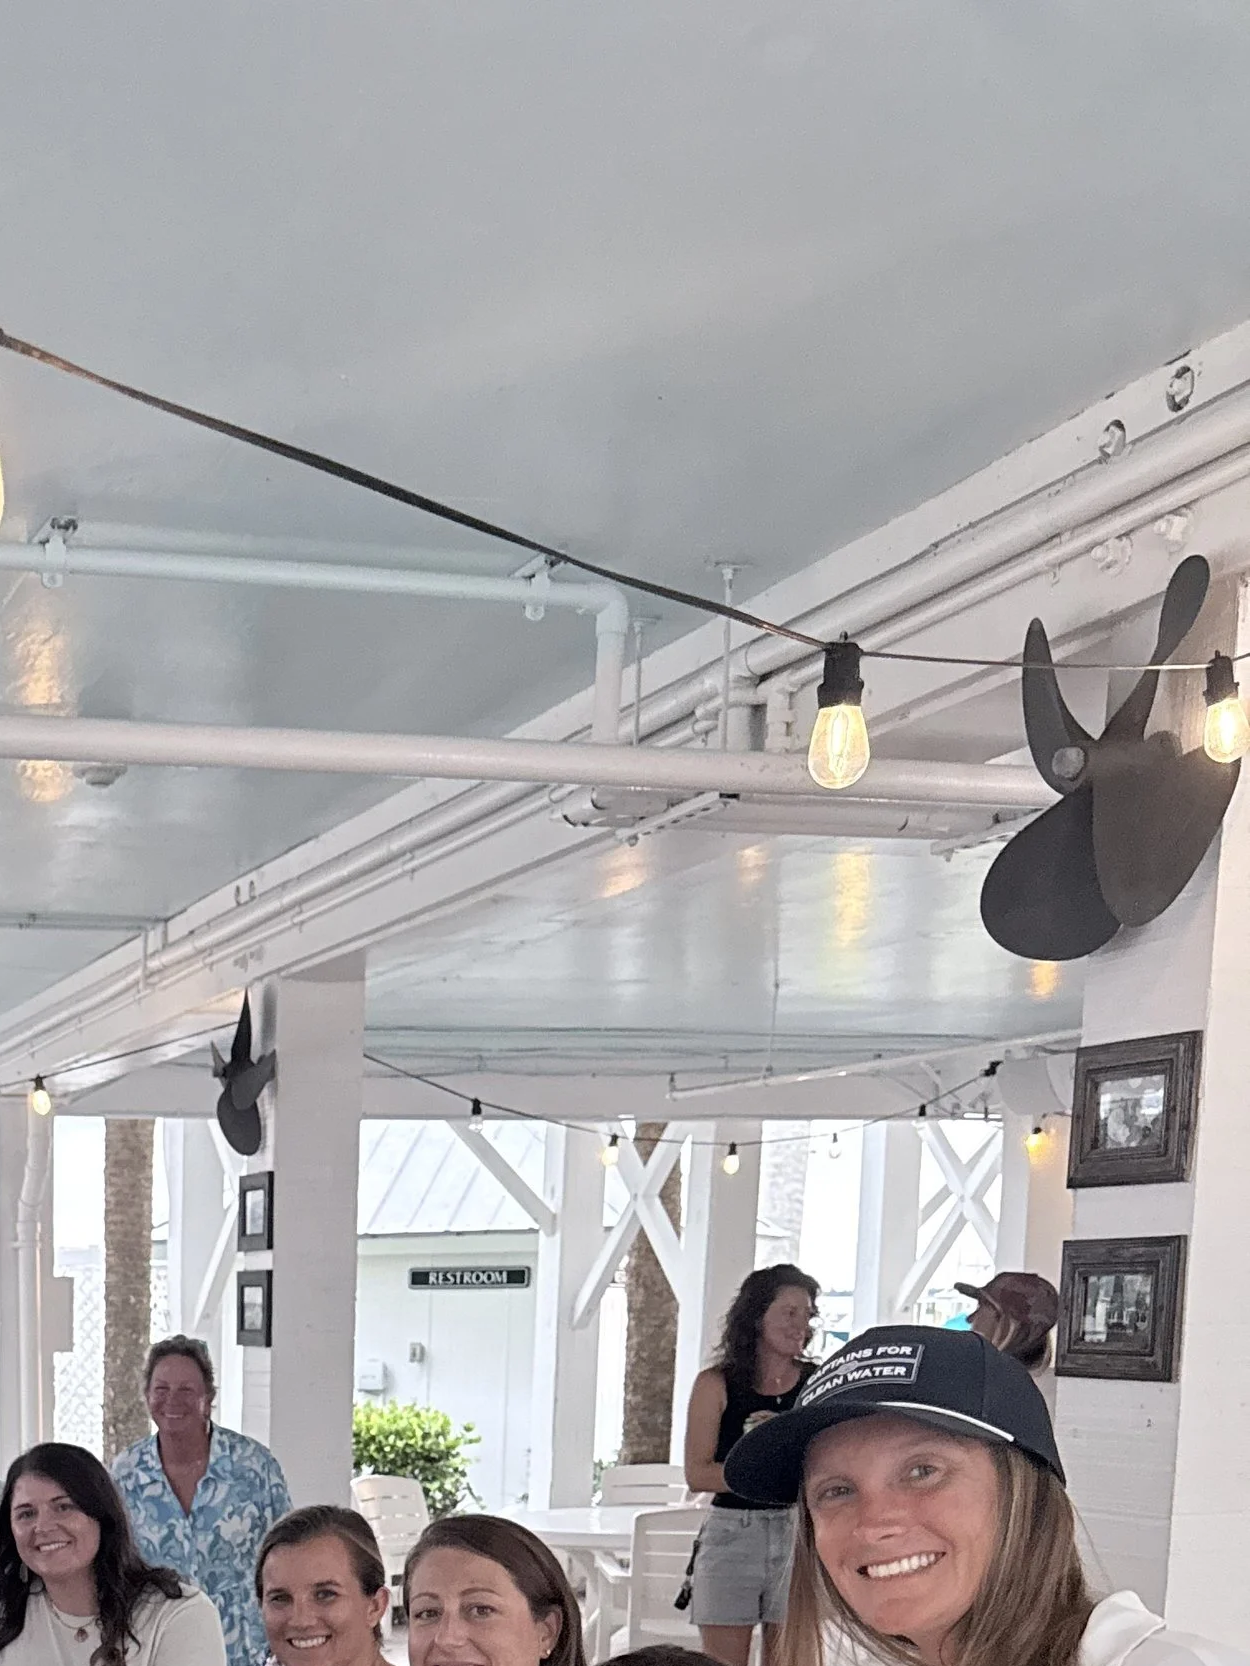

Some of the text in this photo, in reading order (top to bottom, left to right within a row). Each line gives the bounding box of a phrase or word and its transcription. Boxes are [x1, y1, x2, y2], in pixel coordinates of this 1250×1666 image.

[429, 1271, 507, 1285] RESTROOM
[801, 1365, 907, 1407] CLEAN WATER
[806, 1345, 913, 1386] CAPTAINS FOR
